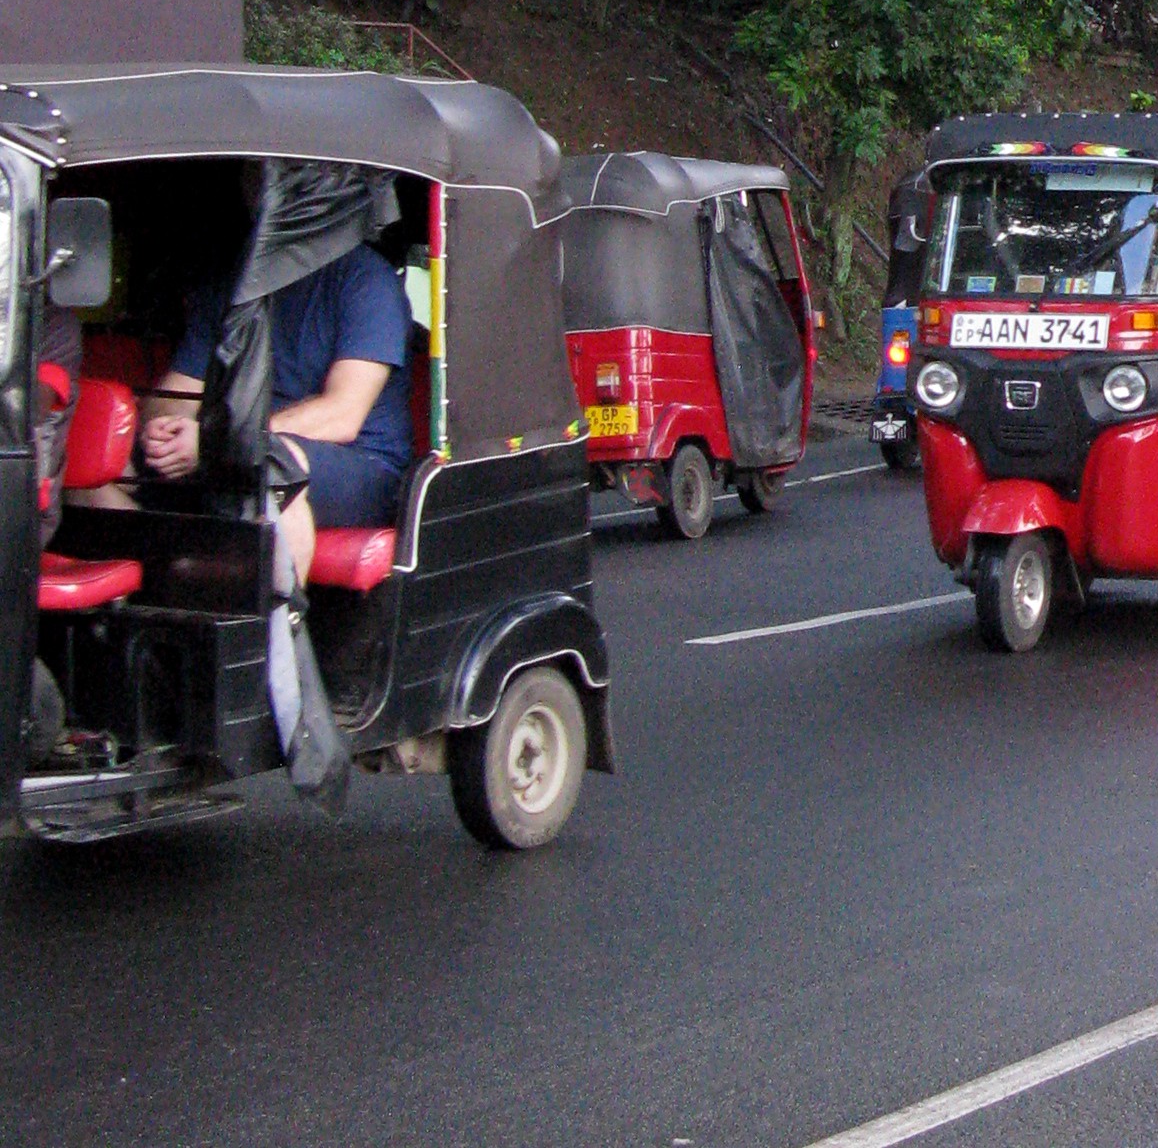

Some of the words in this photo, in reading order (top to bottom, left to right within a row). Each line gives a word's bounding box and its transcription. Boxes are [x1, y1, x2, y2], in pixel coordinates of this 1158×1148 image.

[979, 318, 1029, 343] AAN
[1040, 319, 1101, 344] 3741
[602, 408, 618, 421] GP
[600, 423, 628, 435] 2759
